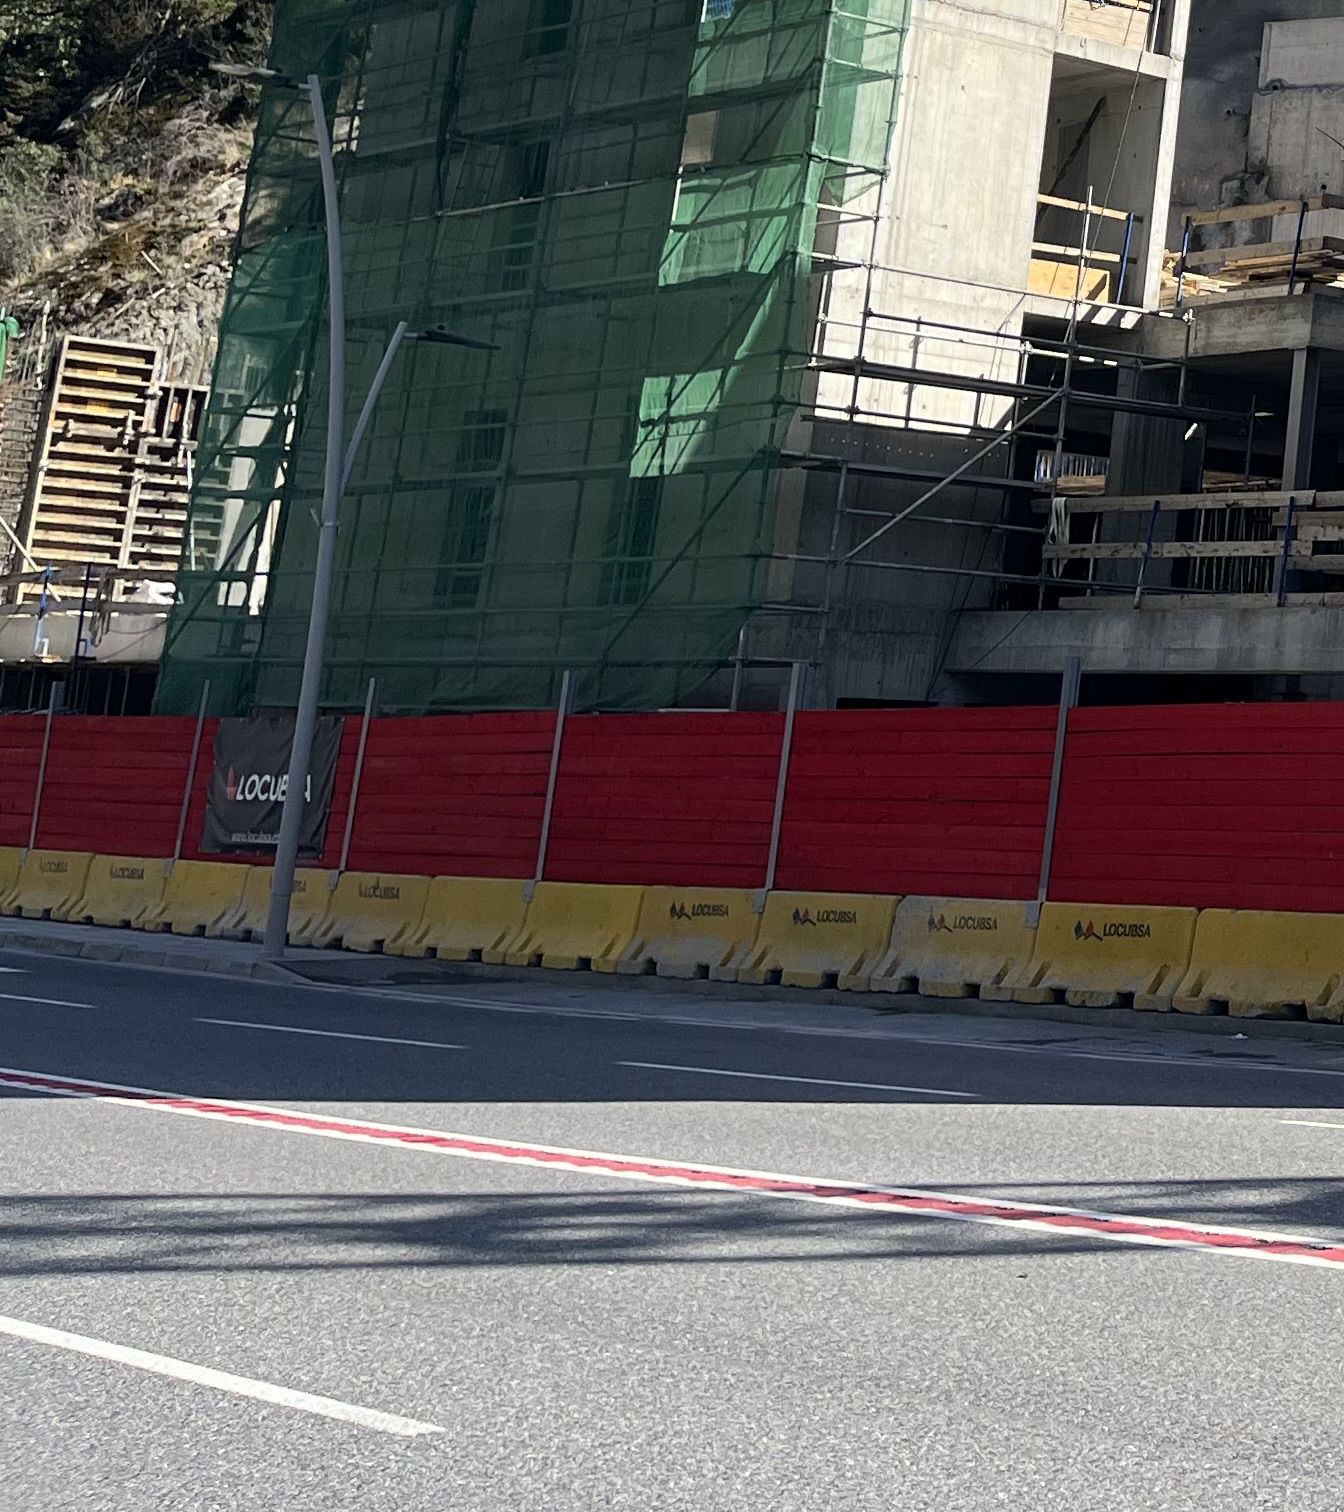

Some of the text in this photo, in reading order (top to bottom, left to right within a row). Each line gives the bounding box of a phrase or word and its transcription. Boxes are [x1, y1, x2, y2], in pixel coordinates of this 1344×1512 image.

[691, 903, 729, 917] LOCUBSA
[816, 909, 857, 924] LOCUBSA
[953, 915, 998, 931] LOCUBSA
[1103, 923, 1150, 938] LOCUBSA
